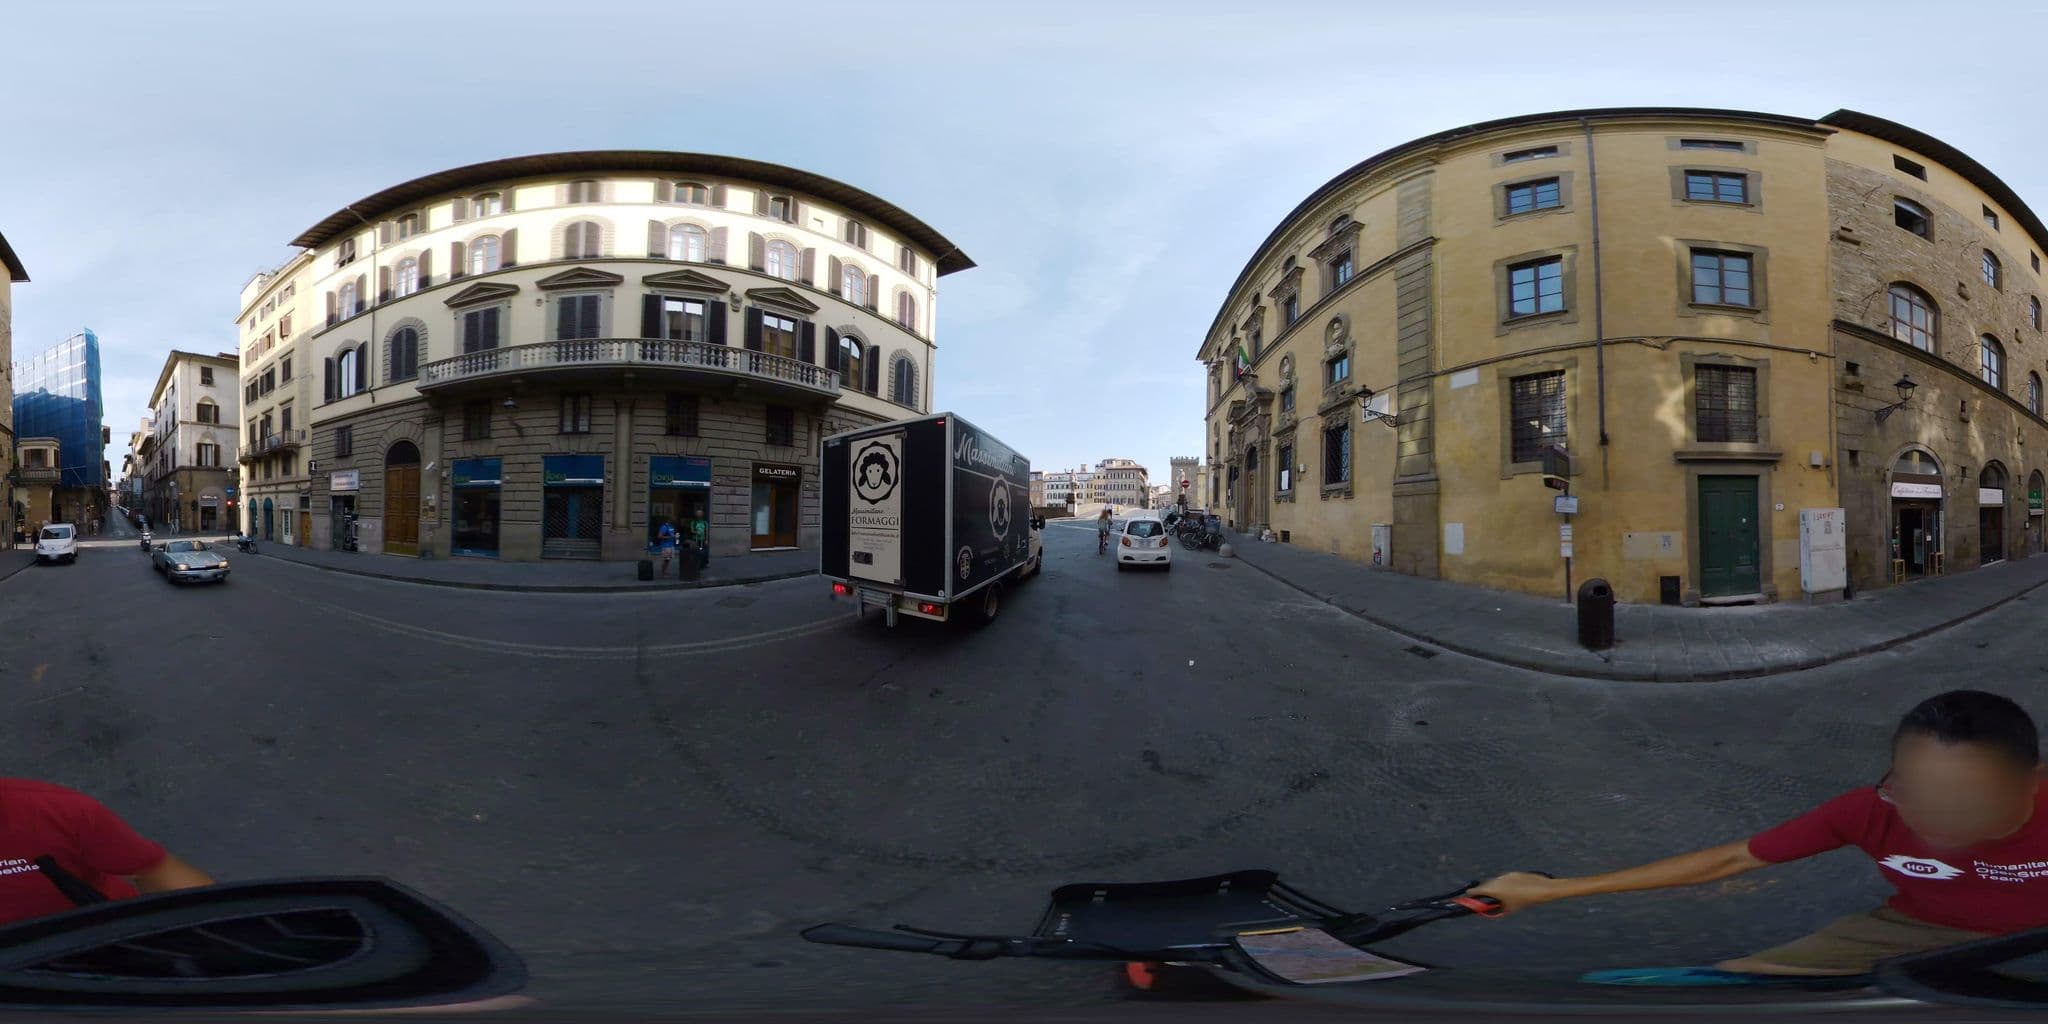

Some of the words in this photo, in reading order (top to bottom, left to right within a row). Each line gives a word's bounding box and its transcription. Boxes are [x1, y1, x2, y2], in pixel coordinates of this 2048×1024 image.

[759, 467, 797, 476] GELATERIA
[851, 516, 899, 526] FORMAGGI
[1906, 863, 1934, 873] HOT
[1974, 860, 2048, 870] Humanita
[1978, 874, 2024, 883] Team
